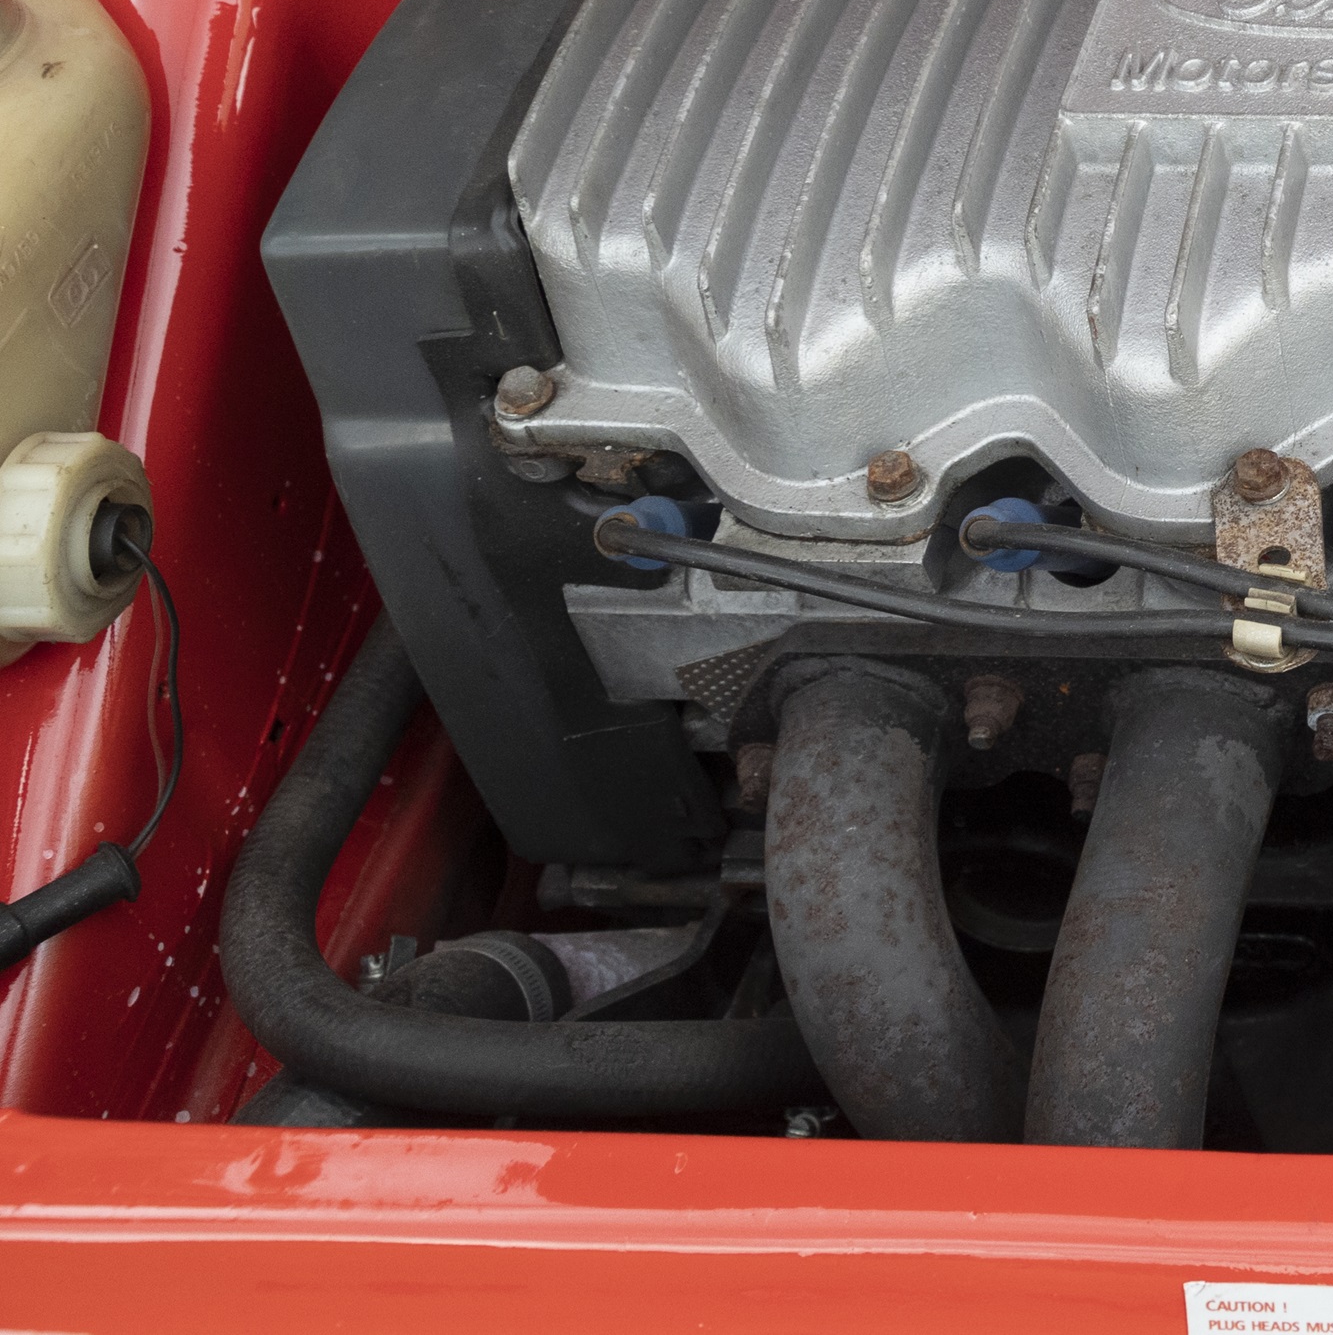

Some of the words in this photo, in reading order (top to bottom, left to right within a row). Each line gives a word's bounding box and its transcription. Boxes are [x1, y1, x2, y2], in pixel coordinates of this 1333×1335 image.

[1206, 1300, 1275, 1313] CAUTION
[1208, 1319, 1246, 1332] PLUG
[1251, 1321, 1300, 1333] HEADS
